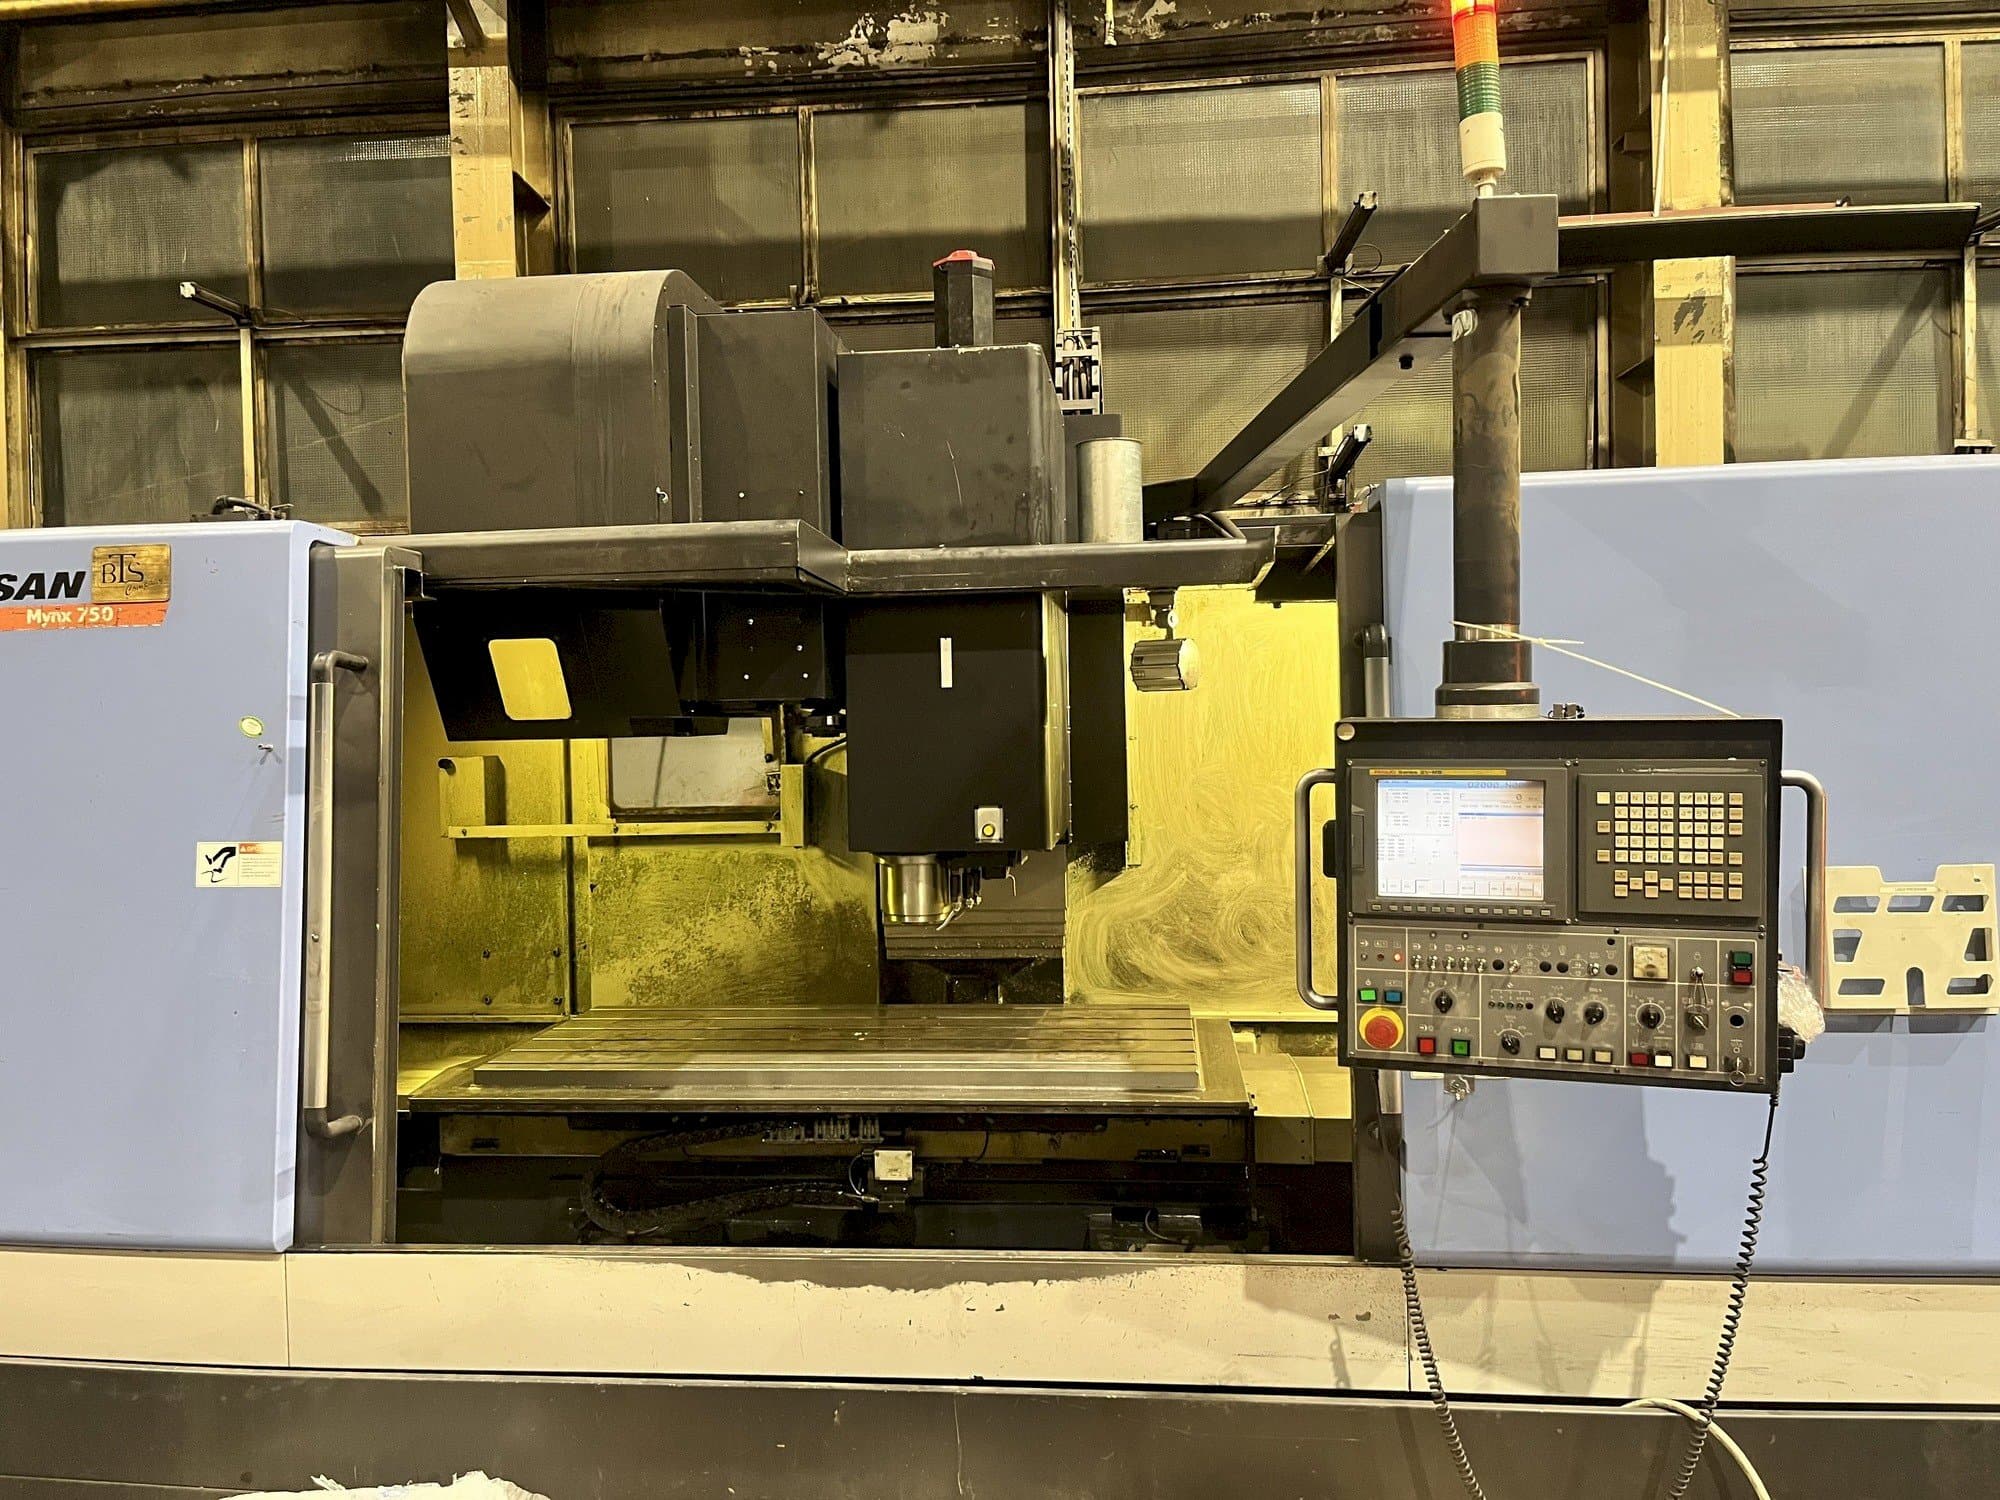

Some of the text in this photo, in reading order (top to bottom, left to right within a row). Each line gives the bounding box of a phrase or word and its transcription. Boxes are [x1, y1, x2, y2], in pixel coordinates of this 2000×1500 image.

[102, 553, 144, 584] BTS
[26, 606, 114, 627] Mynx 750
